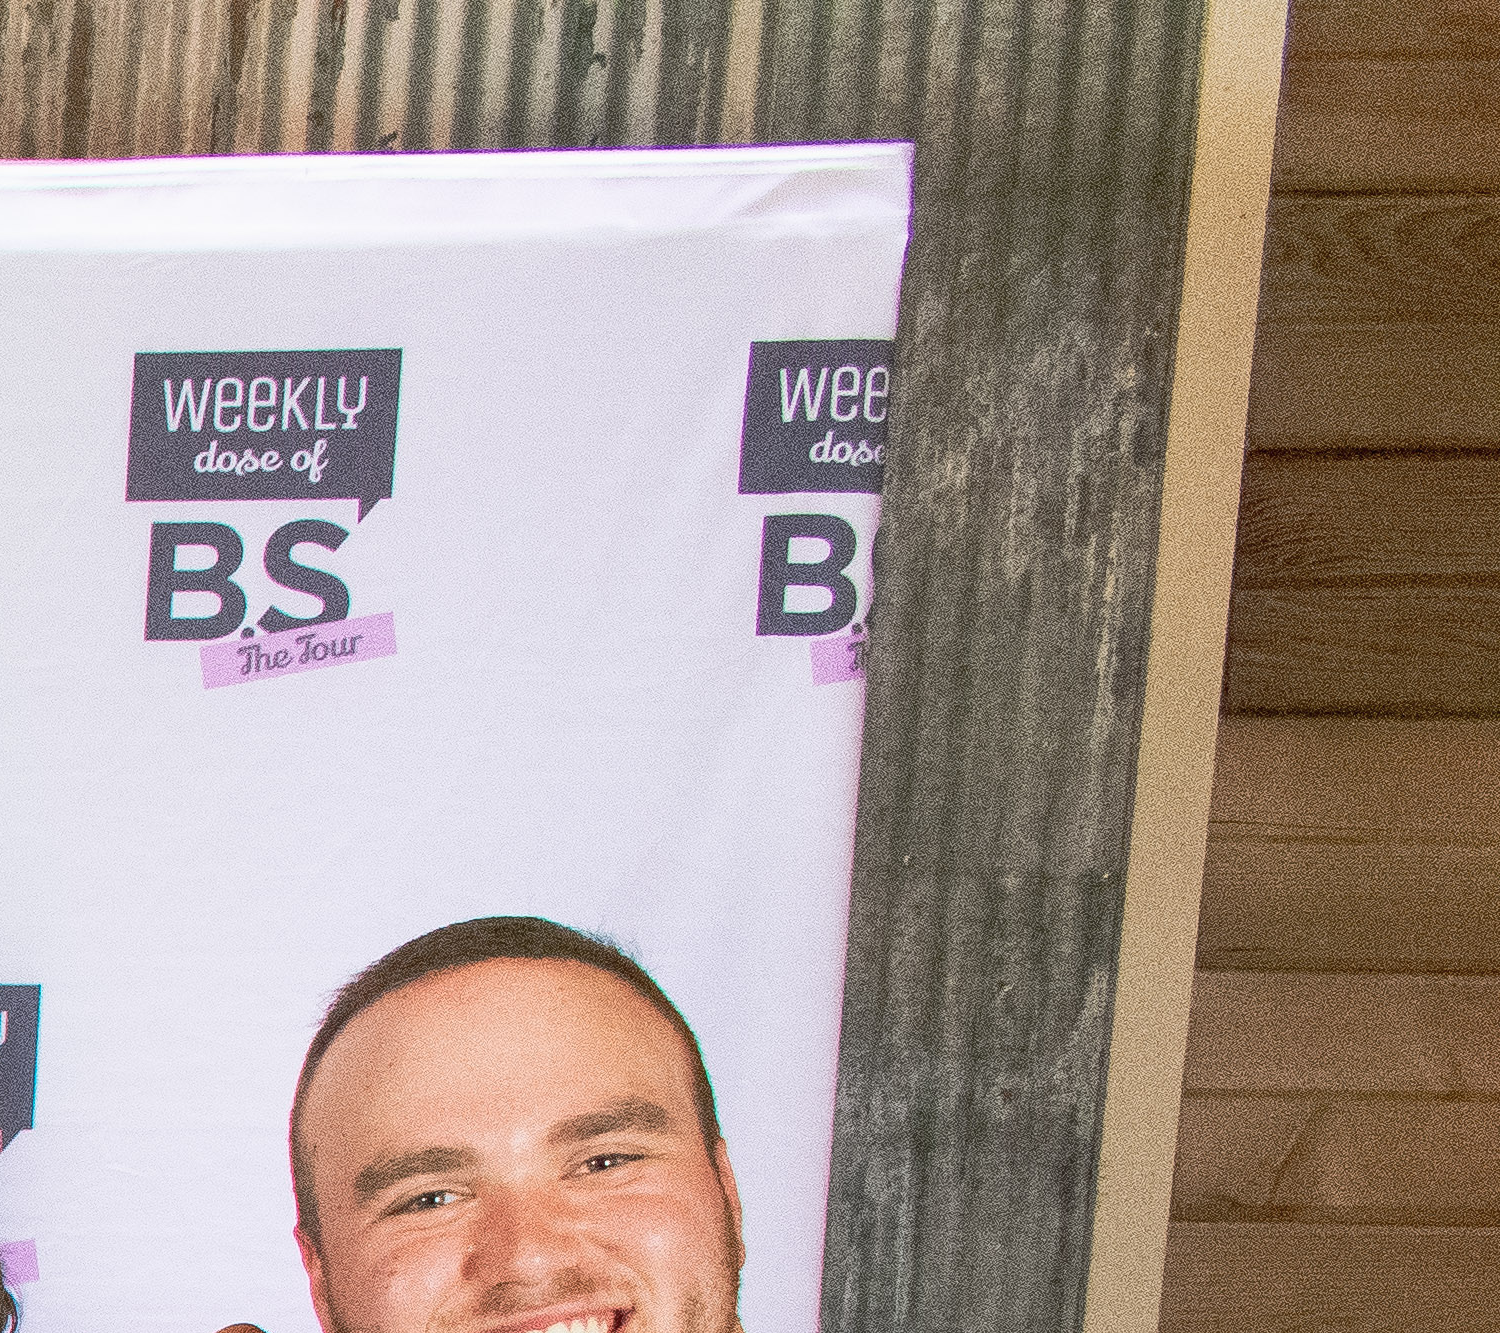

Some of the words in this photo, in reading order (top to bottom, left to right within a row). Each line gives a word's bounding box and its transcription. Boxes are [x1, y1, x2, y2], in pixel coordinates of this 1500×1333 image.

[193, 440, 283, 475] dose
[291, 438, 328, 483] of
[237, 642, 293, 675] The
[296, 633, 363, 665] Tour
